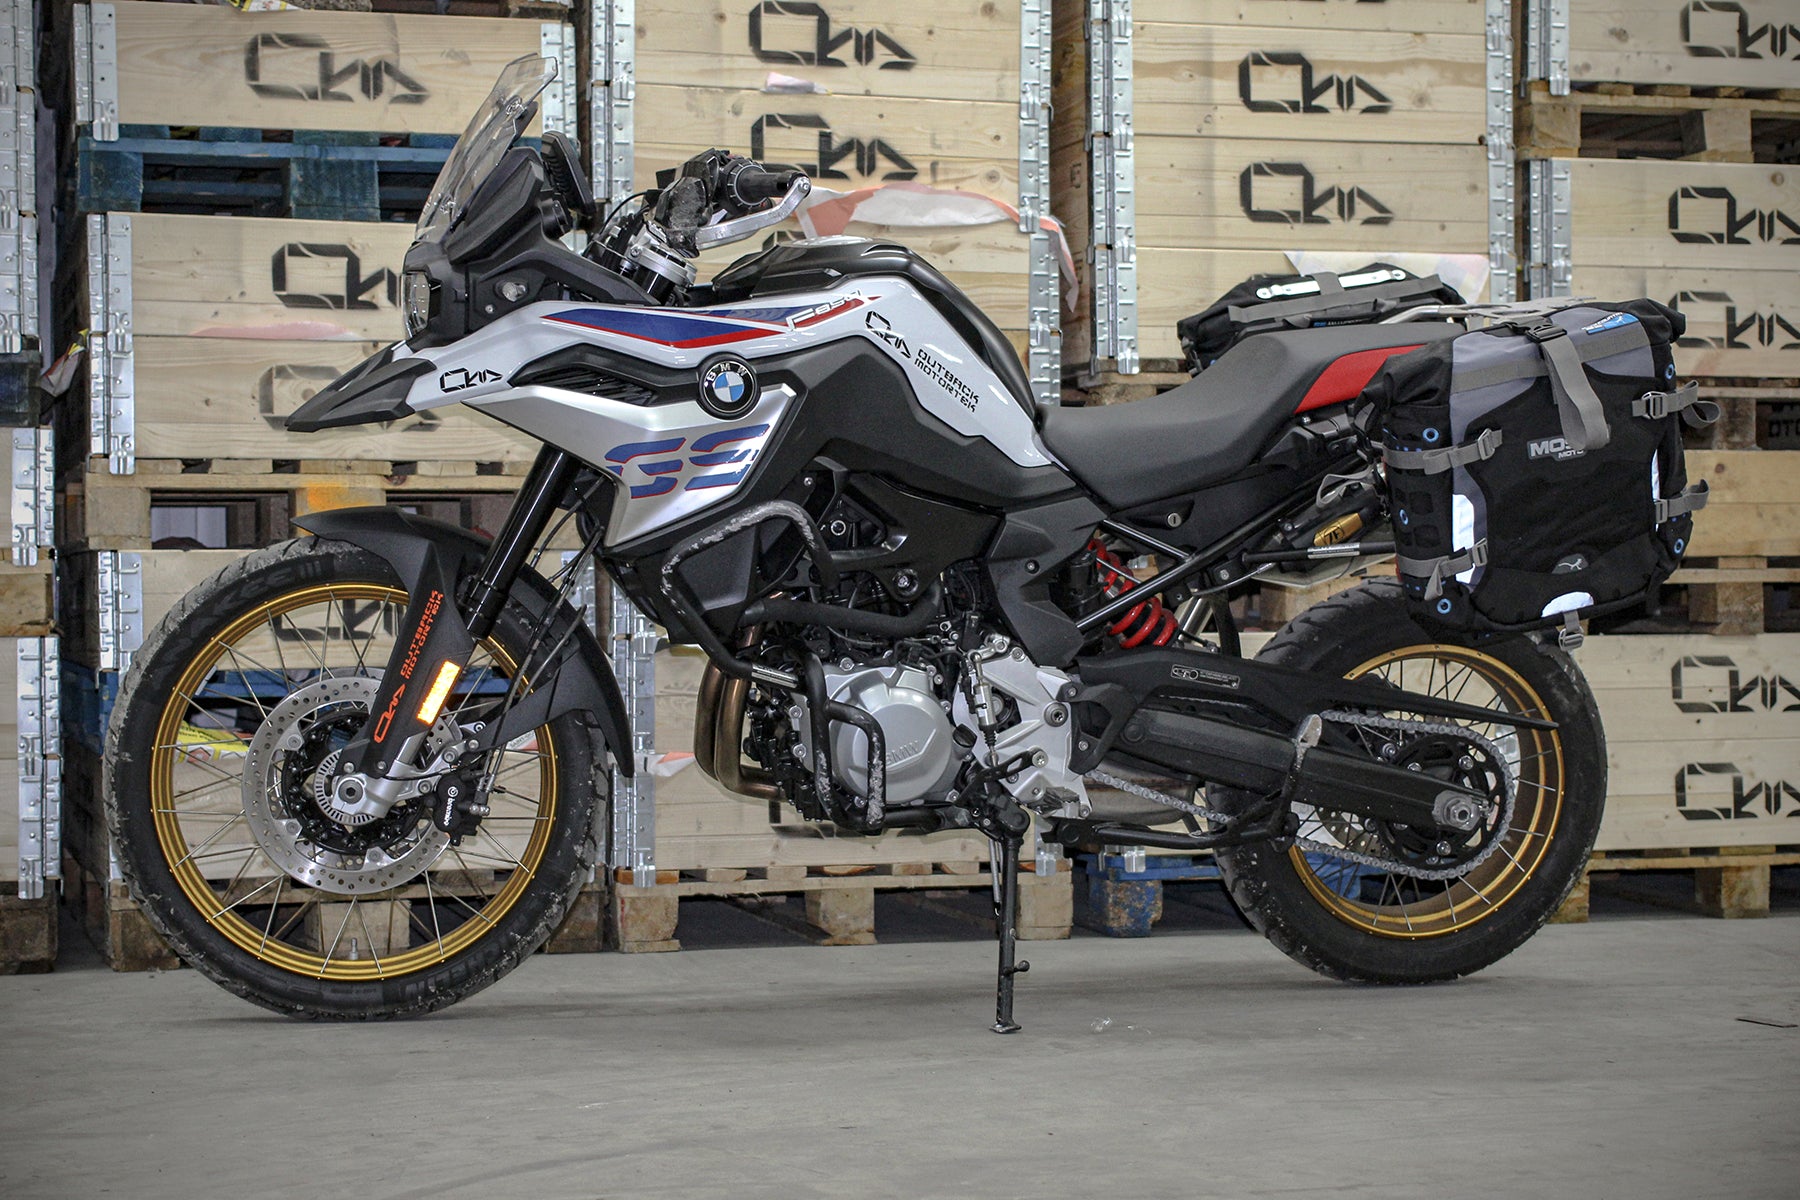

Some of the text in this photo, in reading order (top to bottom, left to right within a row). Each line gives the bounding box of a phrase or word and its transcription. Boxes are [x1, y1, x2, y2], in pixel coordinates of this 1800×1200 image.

[706, 362, 747, 381] BMW
[915, 358, 977, 413] MOTORTEK
[918, 349, 980, 404] OUTBACK
[400, 589, 438, 678] OUTBACK
[404, 592, 444, 680] MOTORTEK
[443, 798, 456, 827] brembo
